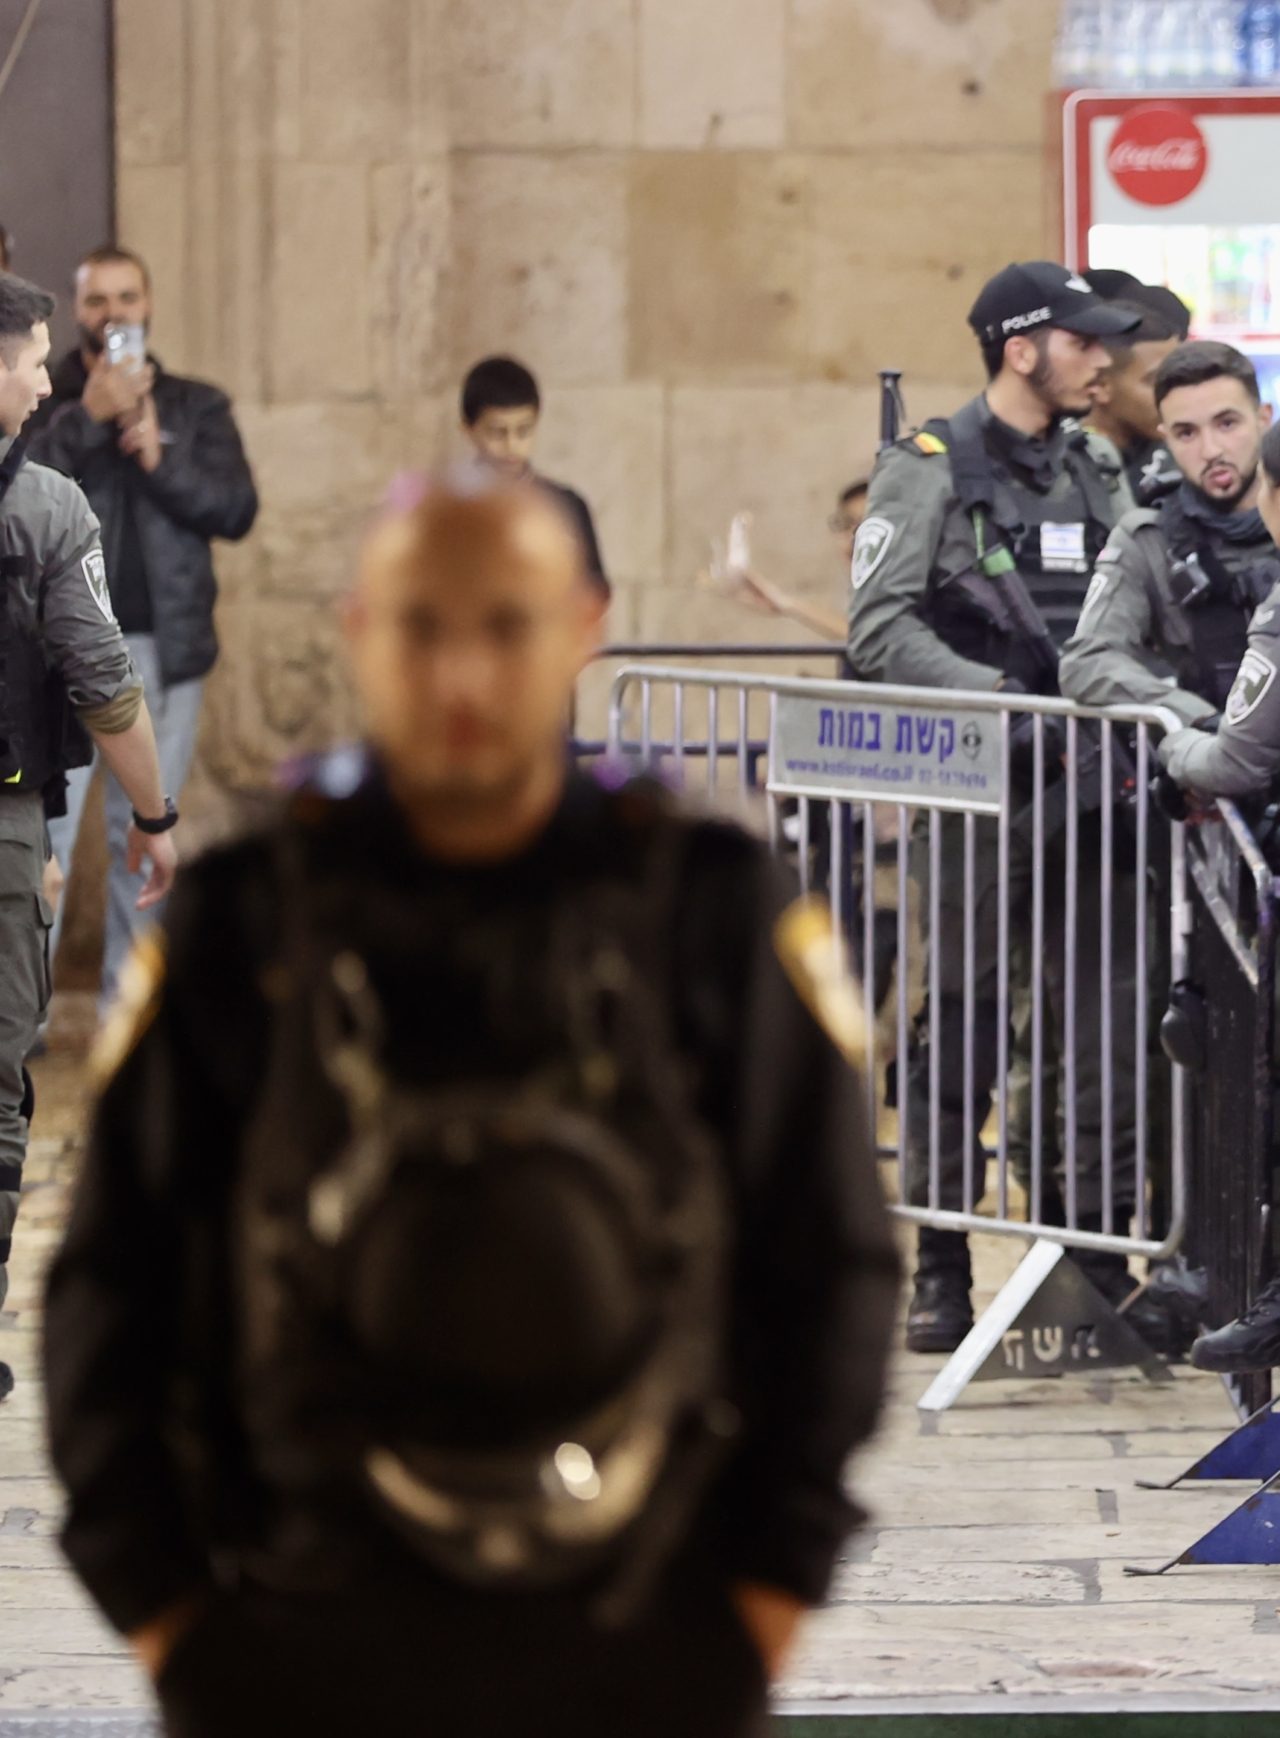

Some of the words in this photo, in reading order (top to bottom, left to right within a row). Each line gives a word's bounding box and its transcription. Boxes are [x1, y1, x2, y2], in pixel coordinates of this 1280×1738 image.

[1001, 306, 1052, 335] POLICE
[818, 708, 881, 751] במות
[895, 714, 955, 763] קשת
